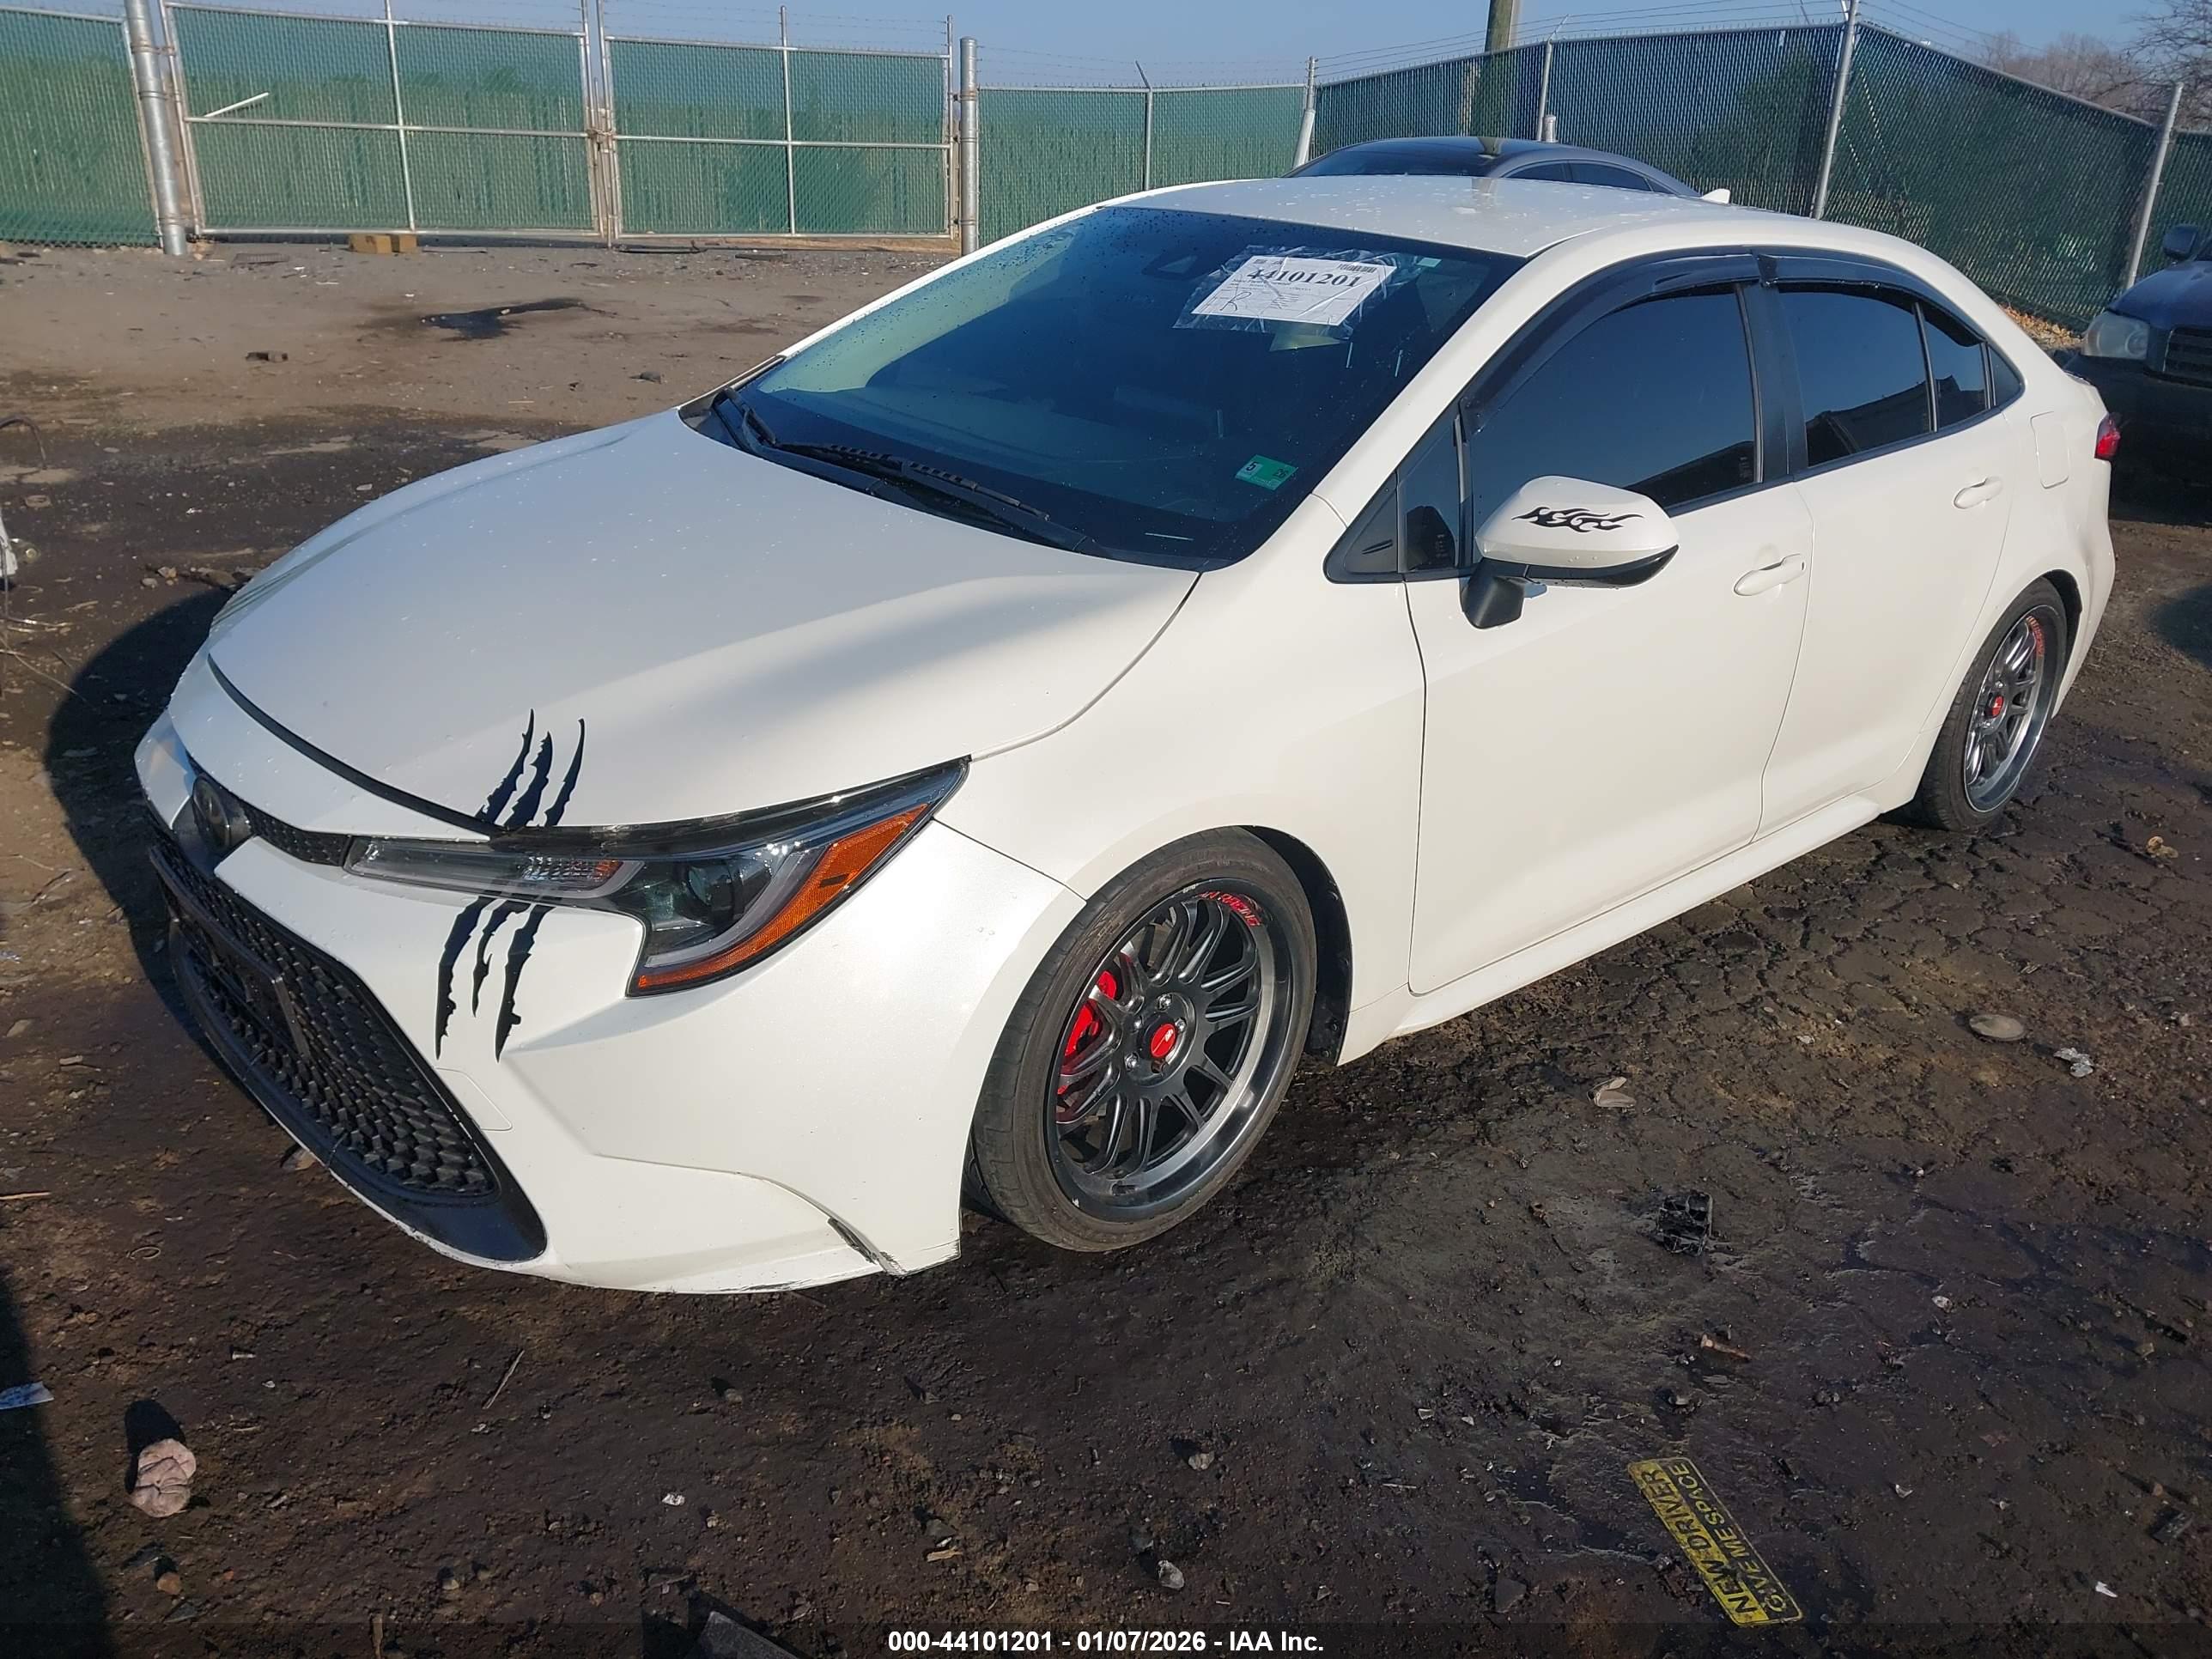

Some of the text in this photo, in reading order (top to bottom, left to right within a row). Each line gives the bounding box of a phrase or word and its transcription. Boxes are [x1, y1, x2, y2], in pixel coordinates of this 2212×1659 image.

[1246, 269, 1362, 287] 44101201
[1246, 461, 1257, 471] 5
[1669, 1462, 1726, 1525] SPACE
[1641, 1469, 1758, 1613] NEW DRIVER
[1714, 1527, 1750, 1559] ME
